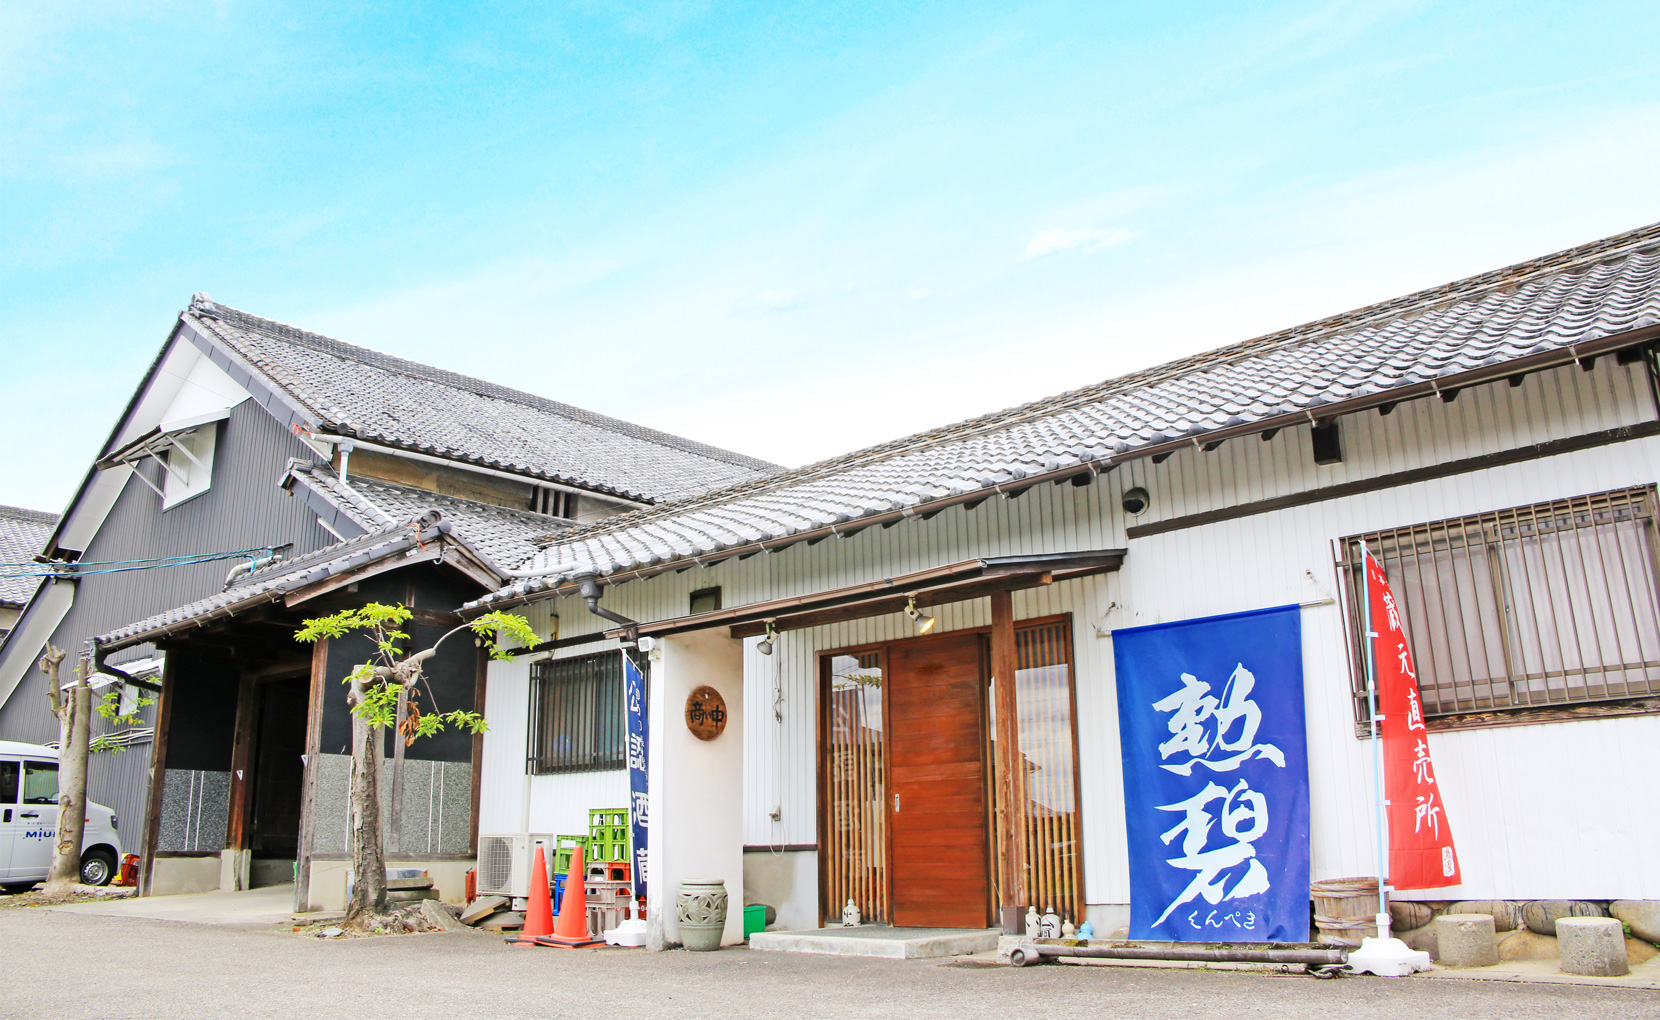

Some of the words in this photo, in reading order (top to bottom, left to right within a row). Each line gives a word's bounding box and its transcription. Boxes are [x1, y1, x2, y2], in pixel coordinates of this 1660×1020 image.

[691, 701, 725, 730] 商い中
[1382, 591, 1441, 841] 蔵元直売所
[1188, 910, 1256, 930] くんぺき
